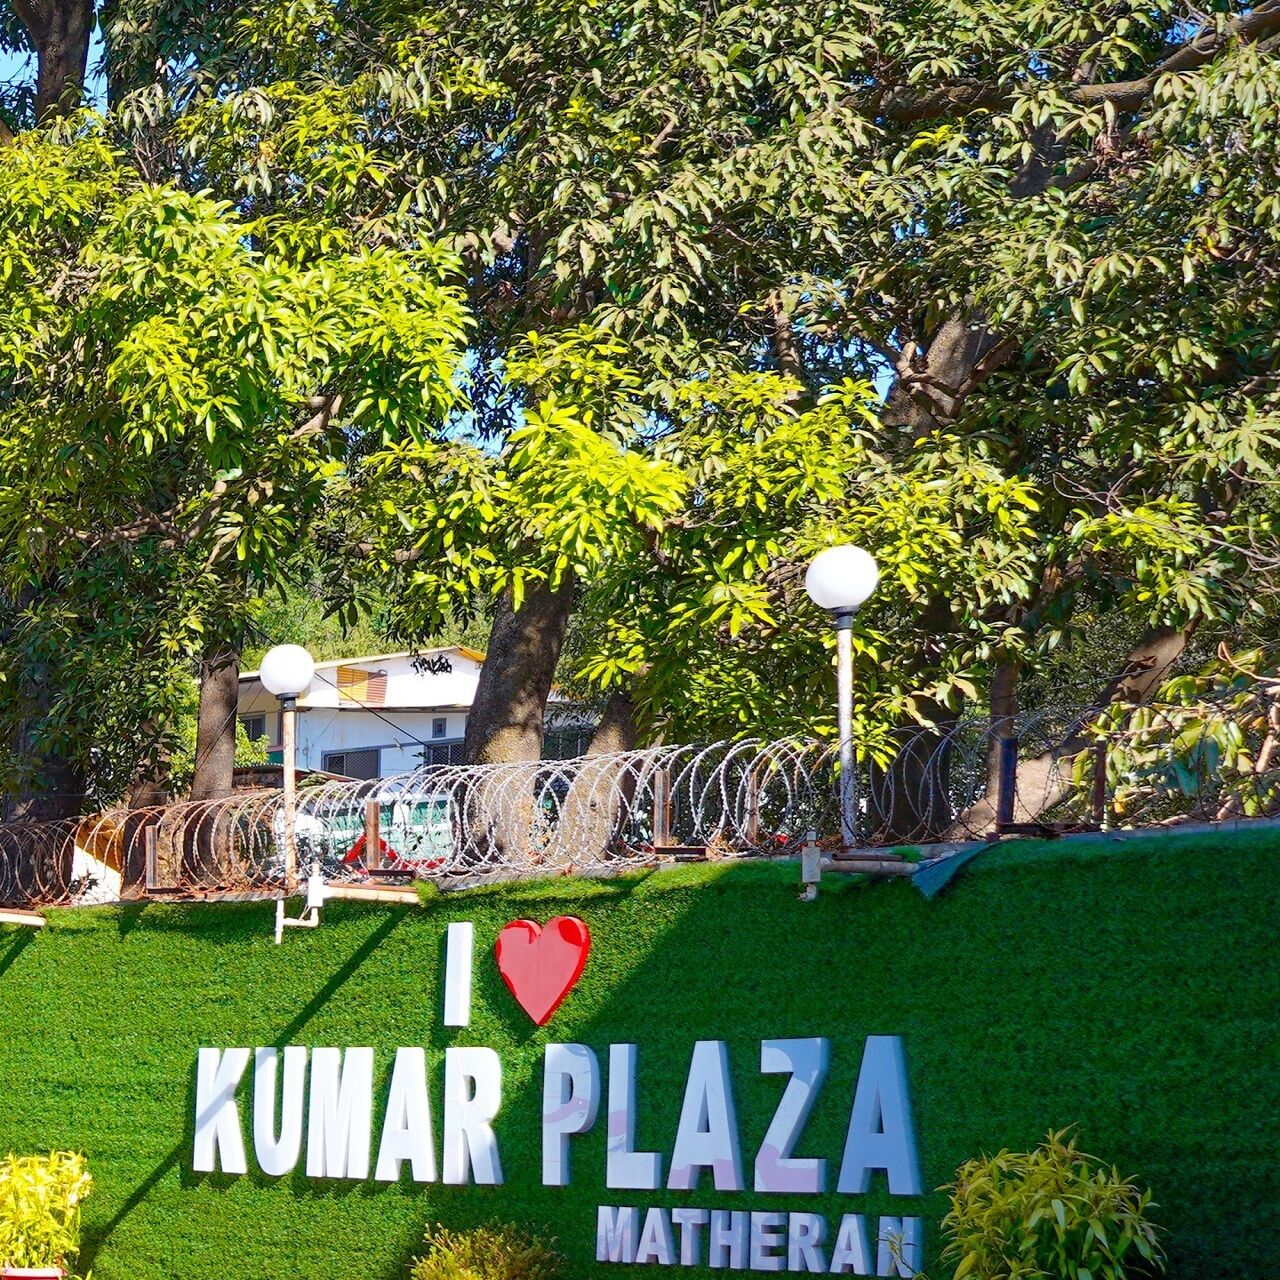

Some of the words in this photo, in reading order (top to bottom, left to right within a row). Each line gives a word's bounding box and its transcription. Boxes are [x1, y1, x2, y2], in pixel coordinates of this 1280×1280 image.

[443, 921, 474, 1028] I
[192, 1045, 505, 1187] KUMAR
[541, 1034, 924, 1196] PLAZA
[595, 1204, 924, 1279] MATHERAN
